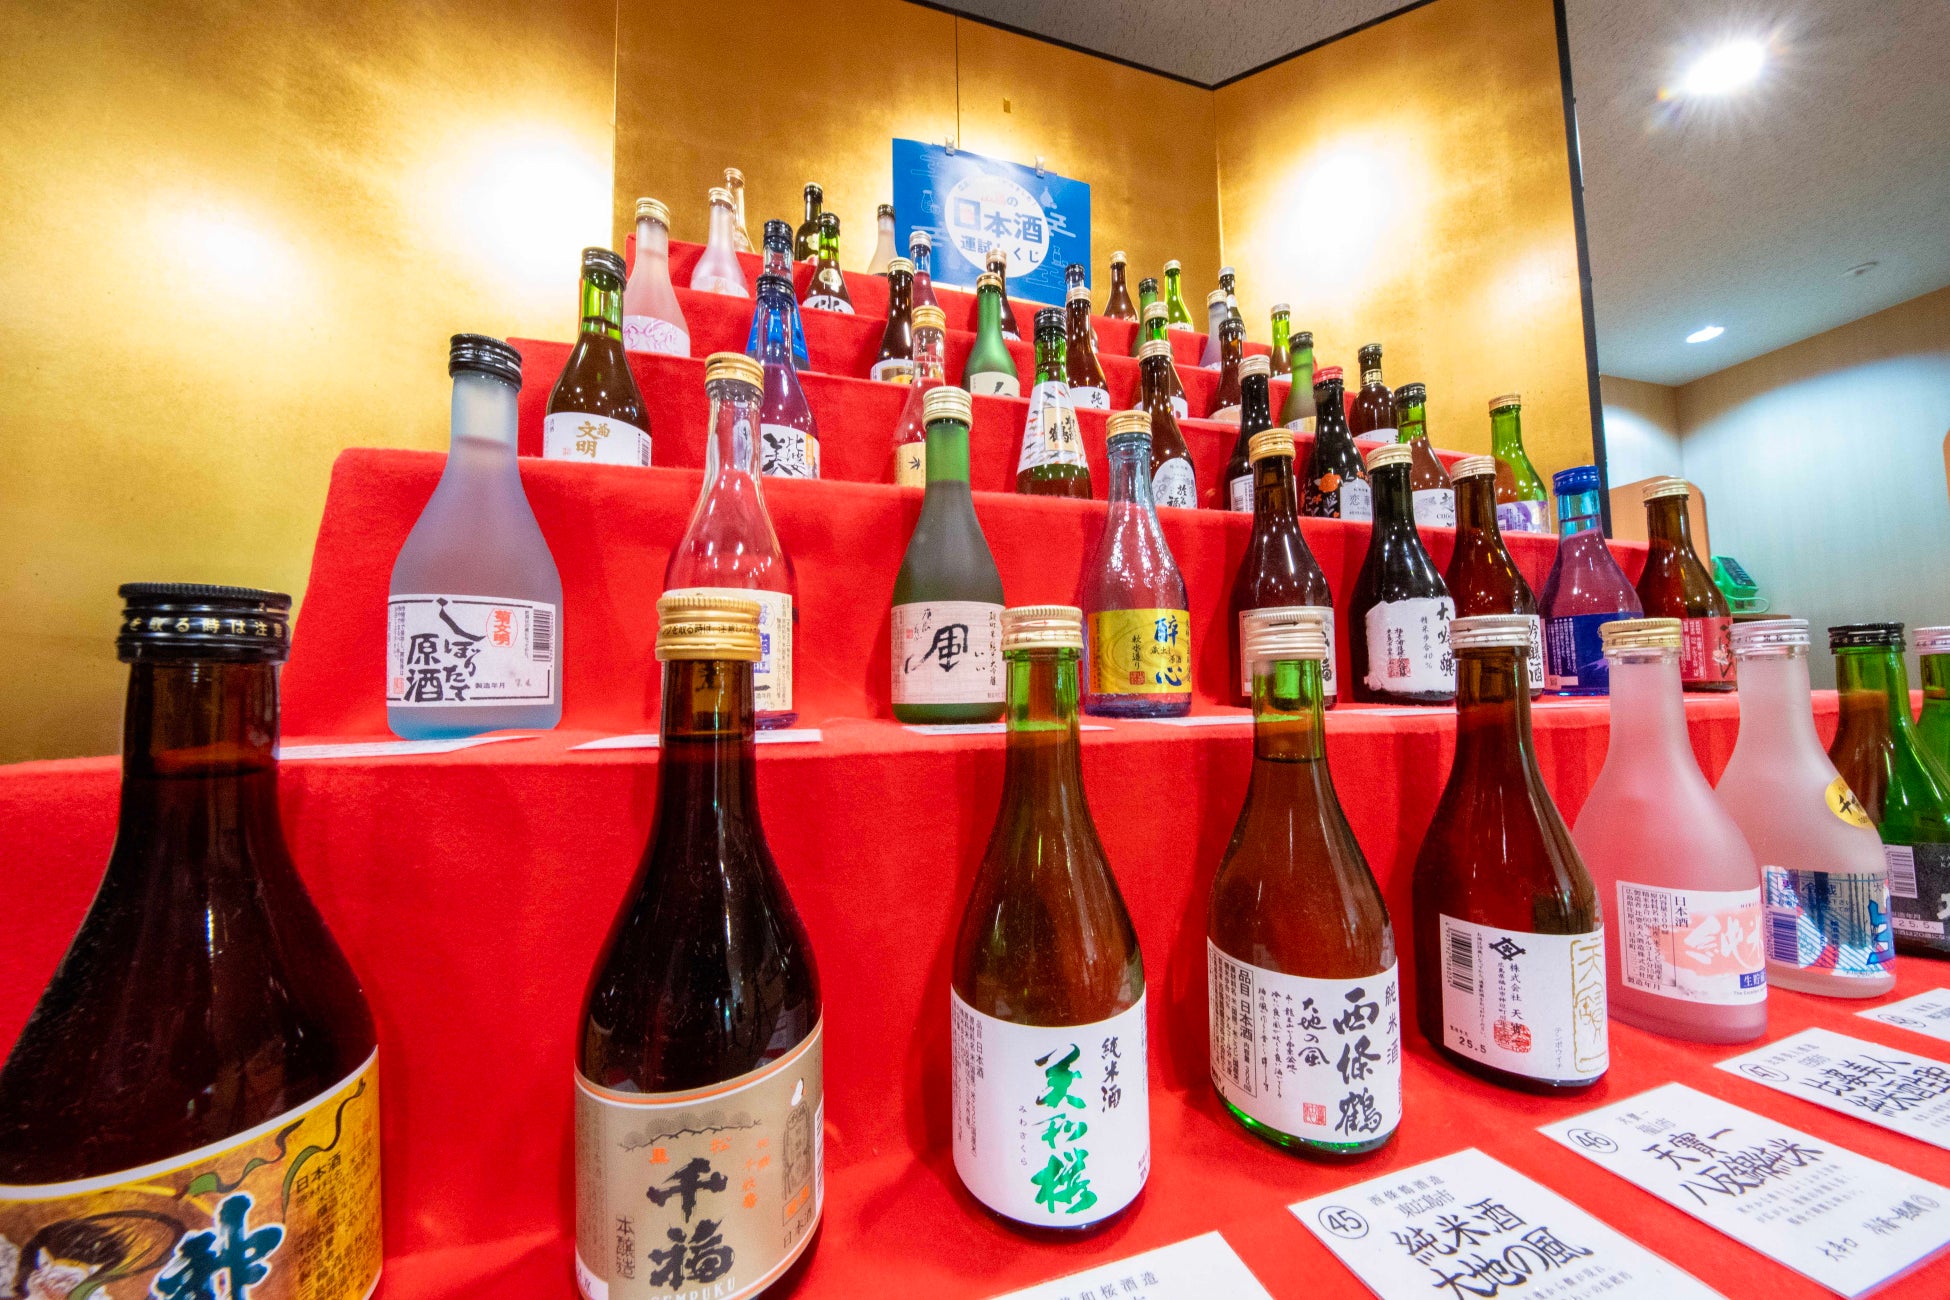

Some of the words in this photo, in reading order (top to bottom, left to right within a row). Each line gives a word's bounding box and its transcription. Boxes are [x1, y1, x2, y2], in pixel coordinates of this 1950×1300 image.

[960, 234, 1040, 264] 運試くじ
[404, 633, 443, 702] 原酒
[1675, 896, 1689, 928] 日本酒
[1239, 969, 1251, 998] 品目
[1510, 962, 1522, 1003] 株式会社
[1239, 1001, 1253, 1043] 日本酒
[1385, 981, 1400, 1066] 純米酒
[976, 1043, 985, 1080] 日本酒
[1332, 987, 1384, 1136] 西條鶴
[1459, 1036, 1488, 1054] 25.5
[1101, 1036, 1122, 1113] 純米酒
[1018, 1105, 1029, 1167] みわさくら
[1571, 1131, 1614, 1152] 46
[295, 1151, 342, 1194] 日本酒
[1368, 1175, 1447, 1206] 西條鶴酒造
[1679, 1138, 1825, 1206] 八反錦純米
[646, 1157, 736, 1291] 千福
[1323, 1208, 1366, 1236] 45
[1395, 1189, 1458, 1218] 東広島市
[1391, 1198, 1528, 1266] 純米酒
[1431, 1226, 1596, 1300] 大地の風
[1058, 1271, 1159, 1300] 和桜酒造
